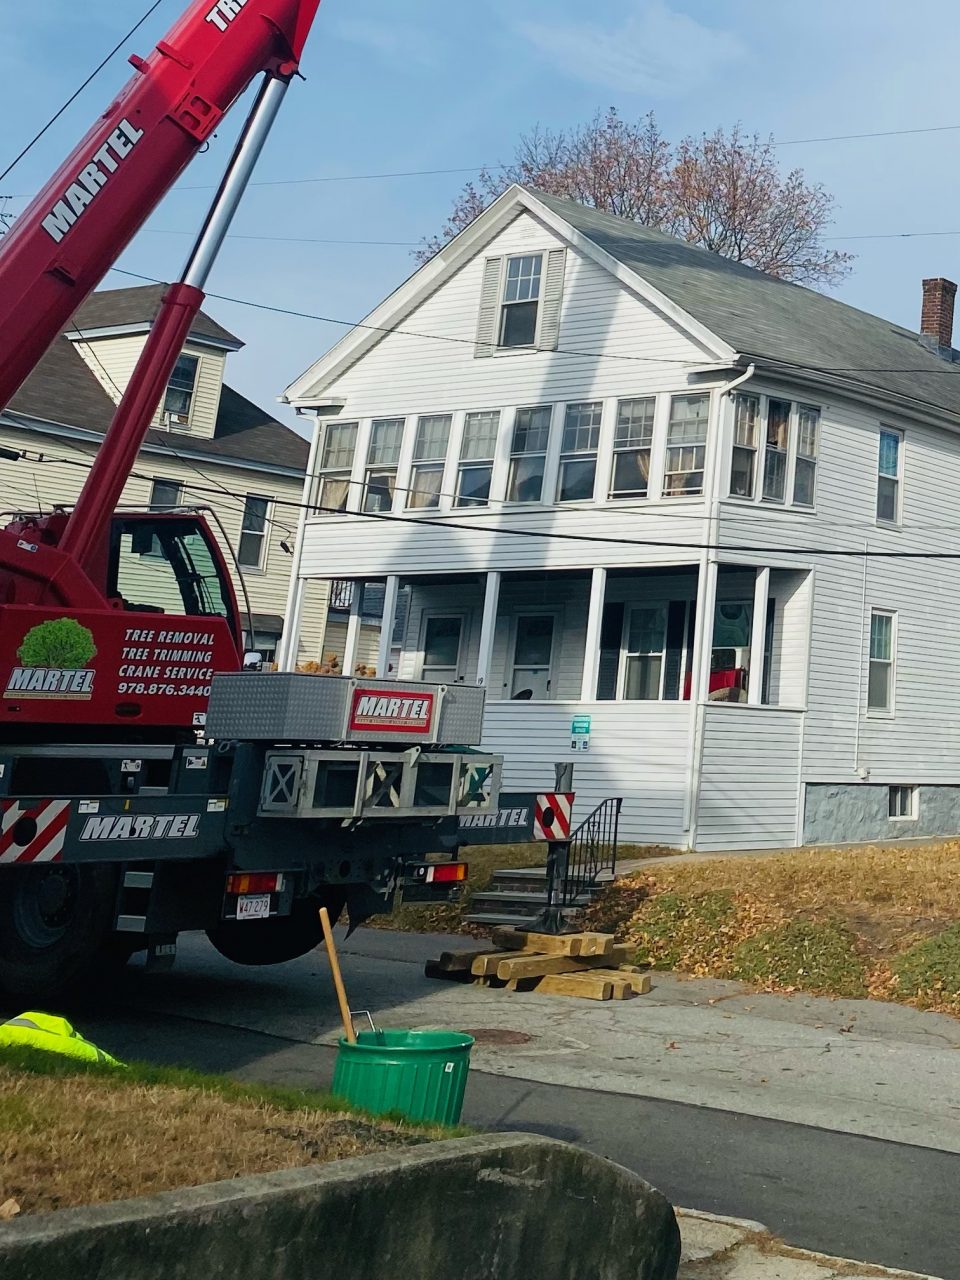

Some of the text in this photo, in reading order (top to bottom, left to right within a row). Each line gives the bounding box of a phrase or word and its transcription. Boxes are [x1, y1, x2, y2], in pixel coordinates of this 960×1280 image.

[41, 118, 144, 243] MARTEL
[124, 629, 215, 645] TREE REMOVAL
[121, 647, 213, 663] TREE TRIMMING
[6, 668, 94, 693] MARTEL
[118, 665, 214, 680] CRANE SERVICE
[117, 682, 211, 697] 978.876.3440
[356, 696, 429, 720] MARTEL
[80, 815, 200, 841] MARTEL
